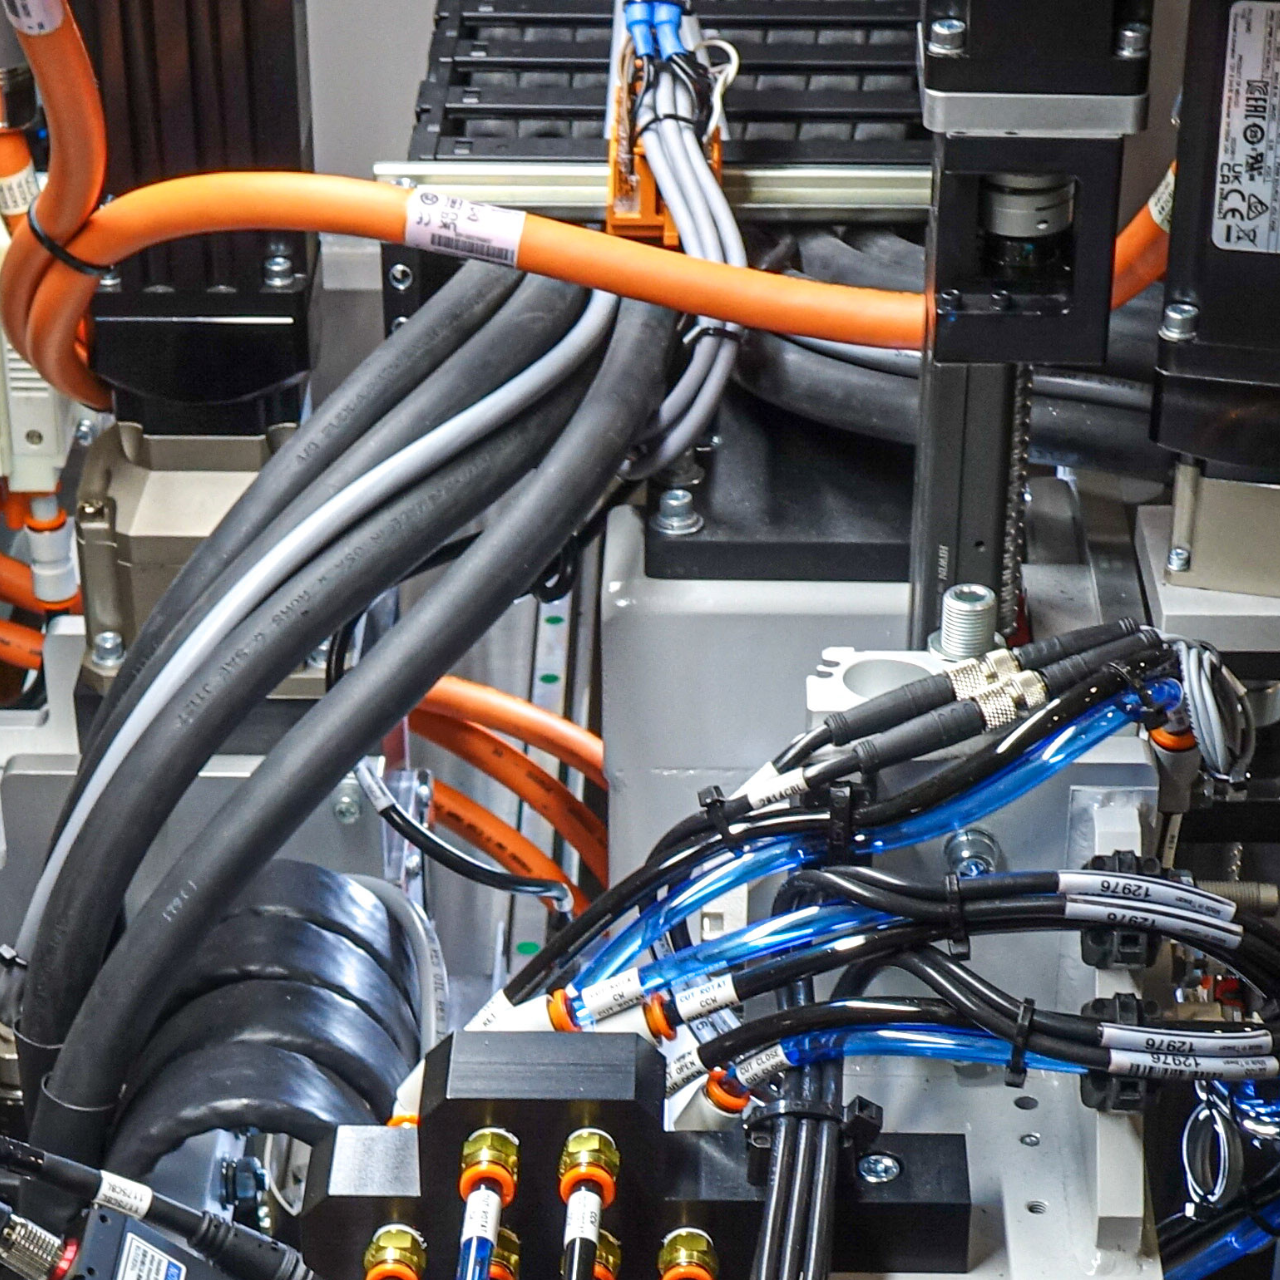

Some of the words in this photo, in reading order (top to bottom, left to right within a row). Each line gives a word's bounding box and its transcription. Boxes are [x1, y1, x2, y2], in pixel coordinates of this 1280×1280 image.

[1100, 880, 1152, 898] 12976
[700, 997, 718, 1009] CCW
[1145, 1037, 1196, 1054] 12976
[675, 1059, 697, 1076] OPEN
[739, 1063, 754, 1076] CUT
[756, 1050, 780, 1067] CLOSE
[1151, 1053, 1201, 1069] 12976
